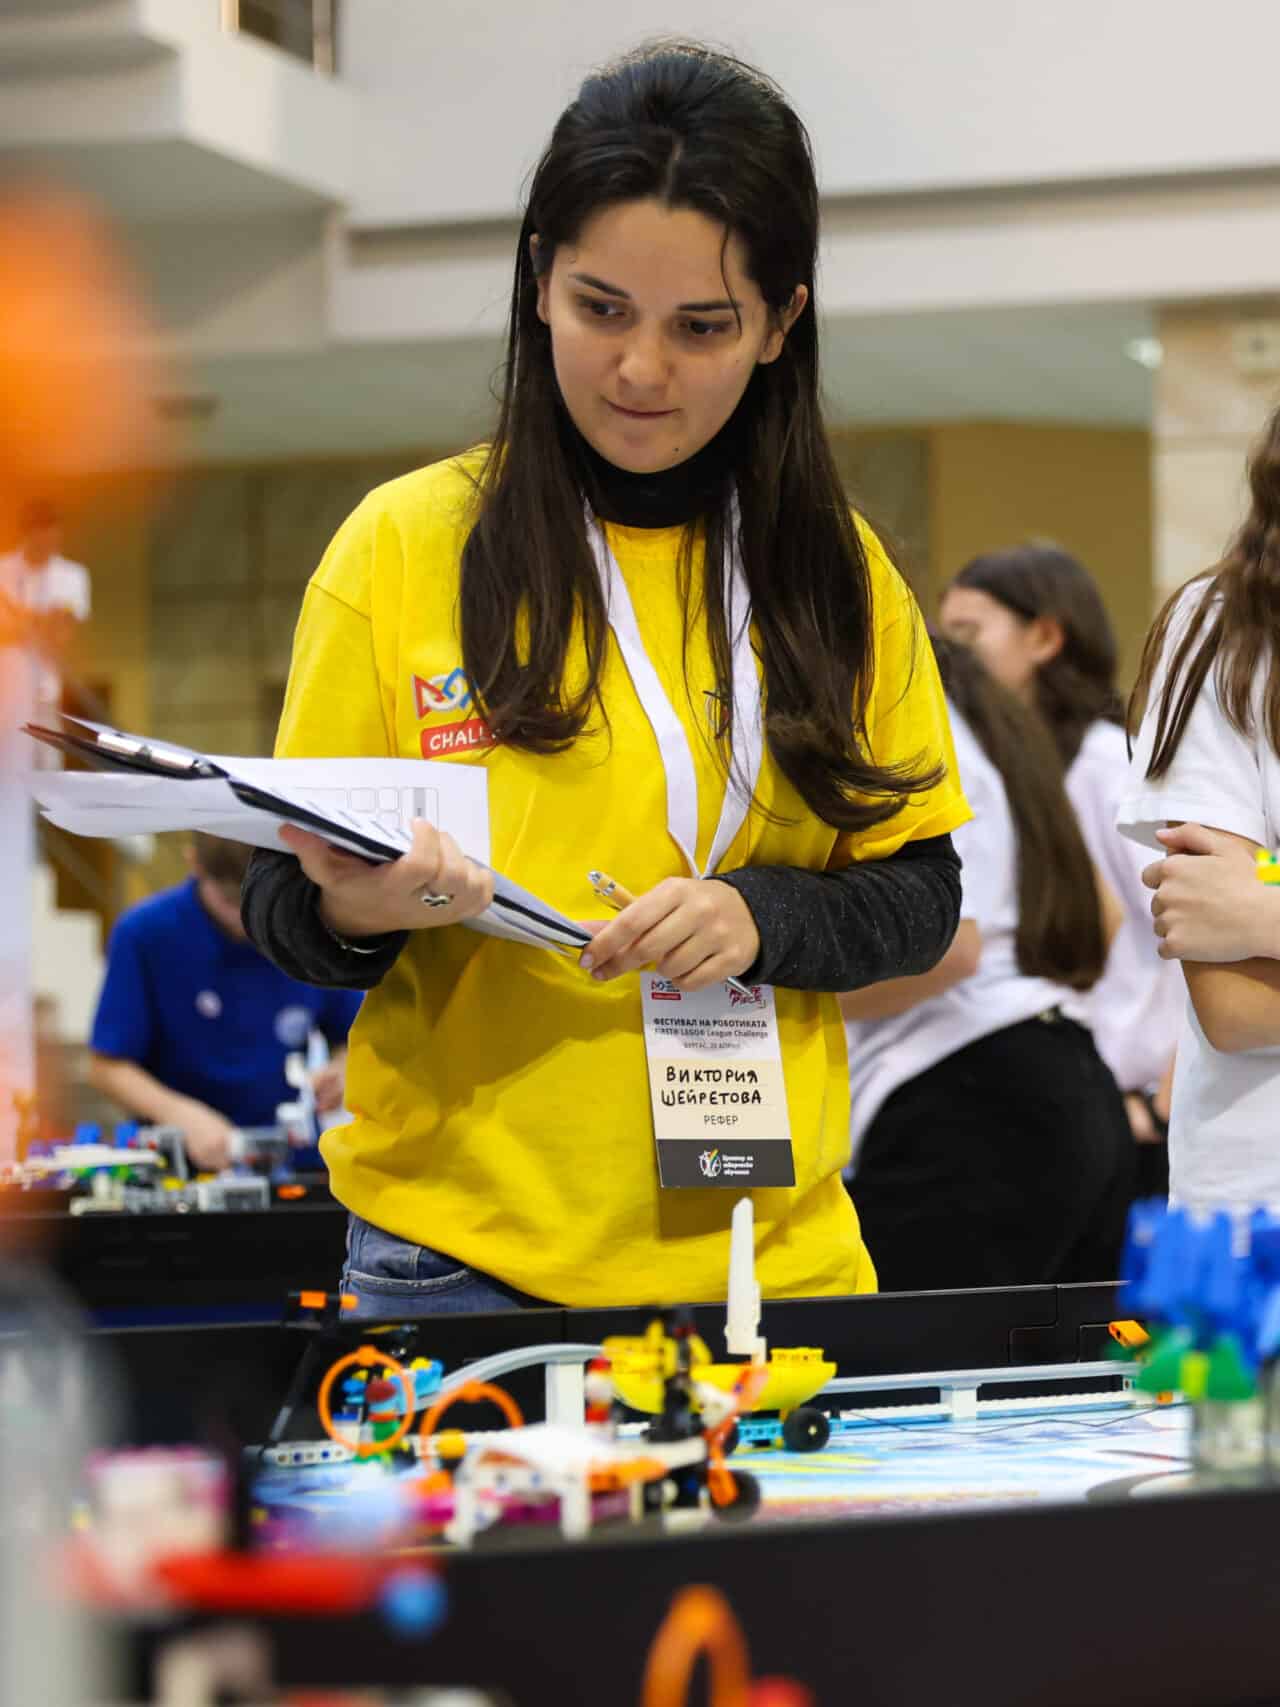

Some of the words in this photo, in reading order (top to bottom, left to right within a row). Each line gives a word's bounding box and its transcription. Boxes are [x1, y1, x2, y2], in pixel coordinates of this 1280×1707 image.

[429, 726, 484, 751] CHALL
[654, 1018, 697, 1026] ФЕСТИВАЛ
[699, 1019, 711, 1027] НА
[666, 1066, 758, 1083] ВИКТОРИЯ
[661, 1089, 762, 1106] ШЕЙРЕТОВА
[703, 1115, 738, 1125] РЕФЕР
